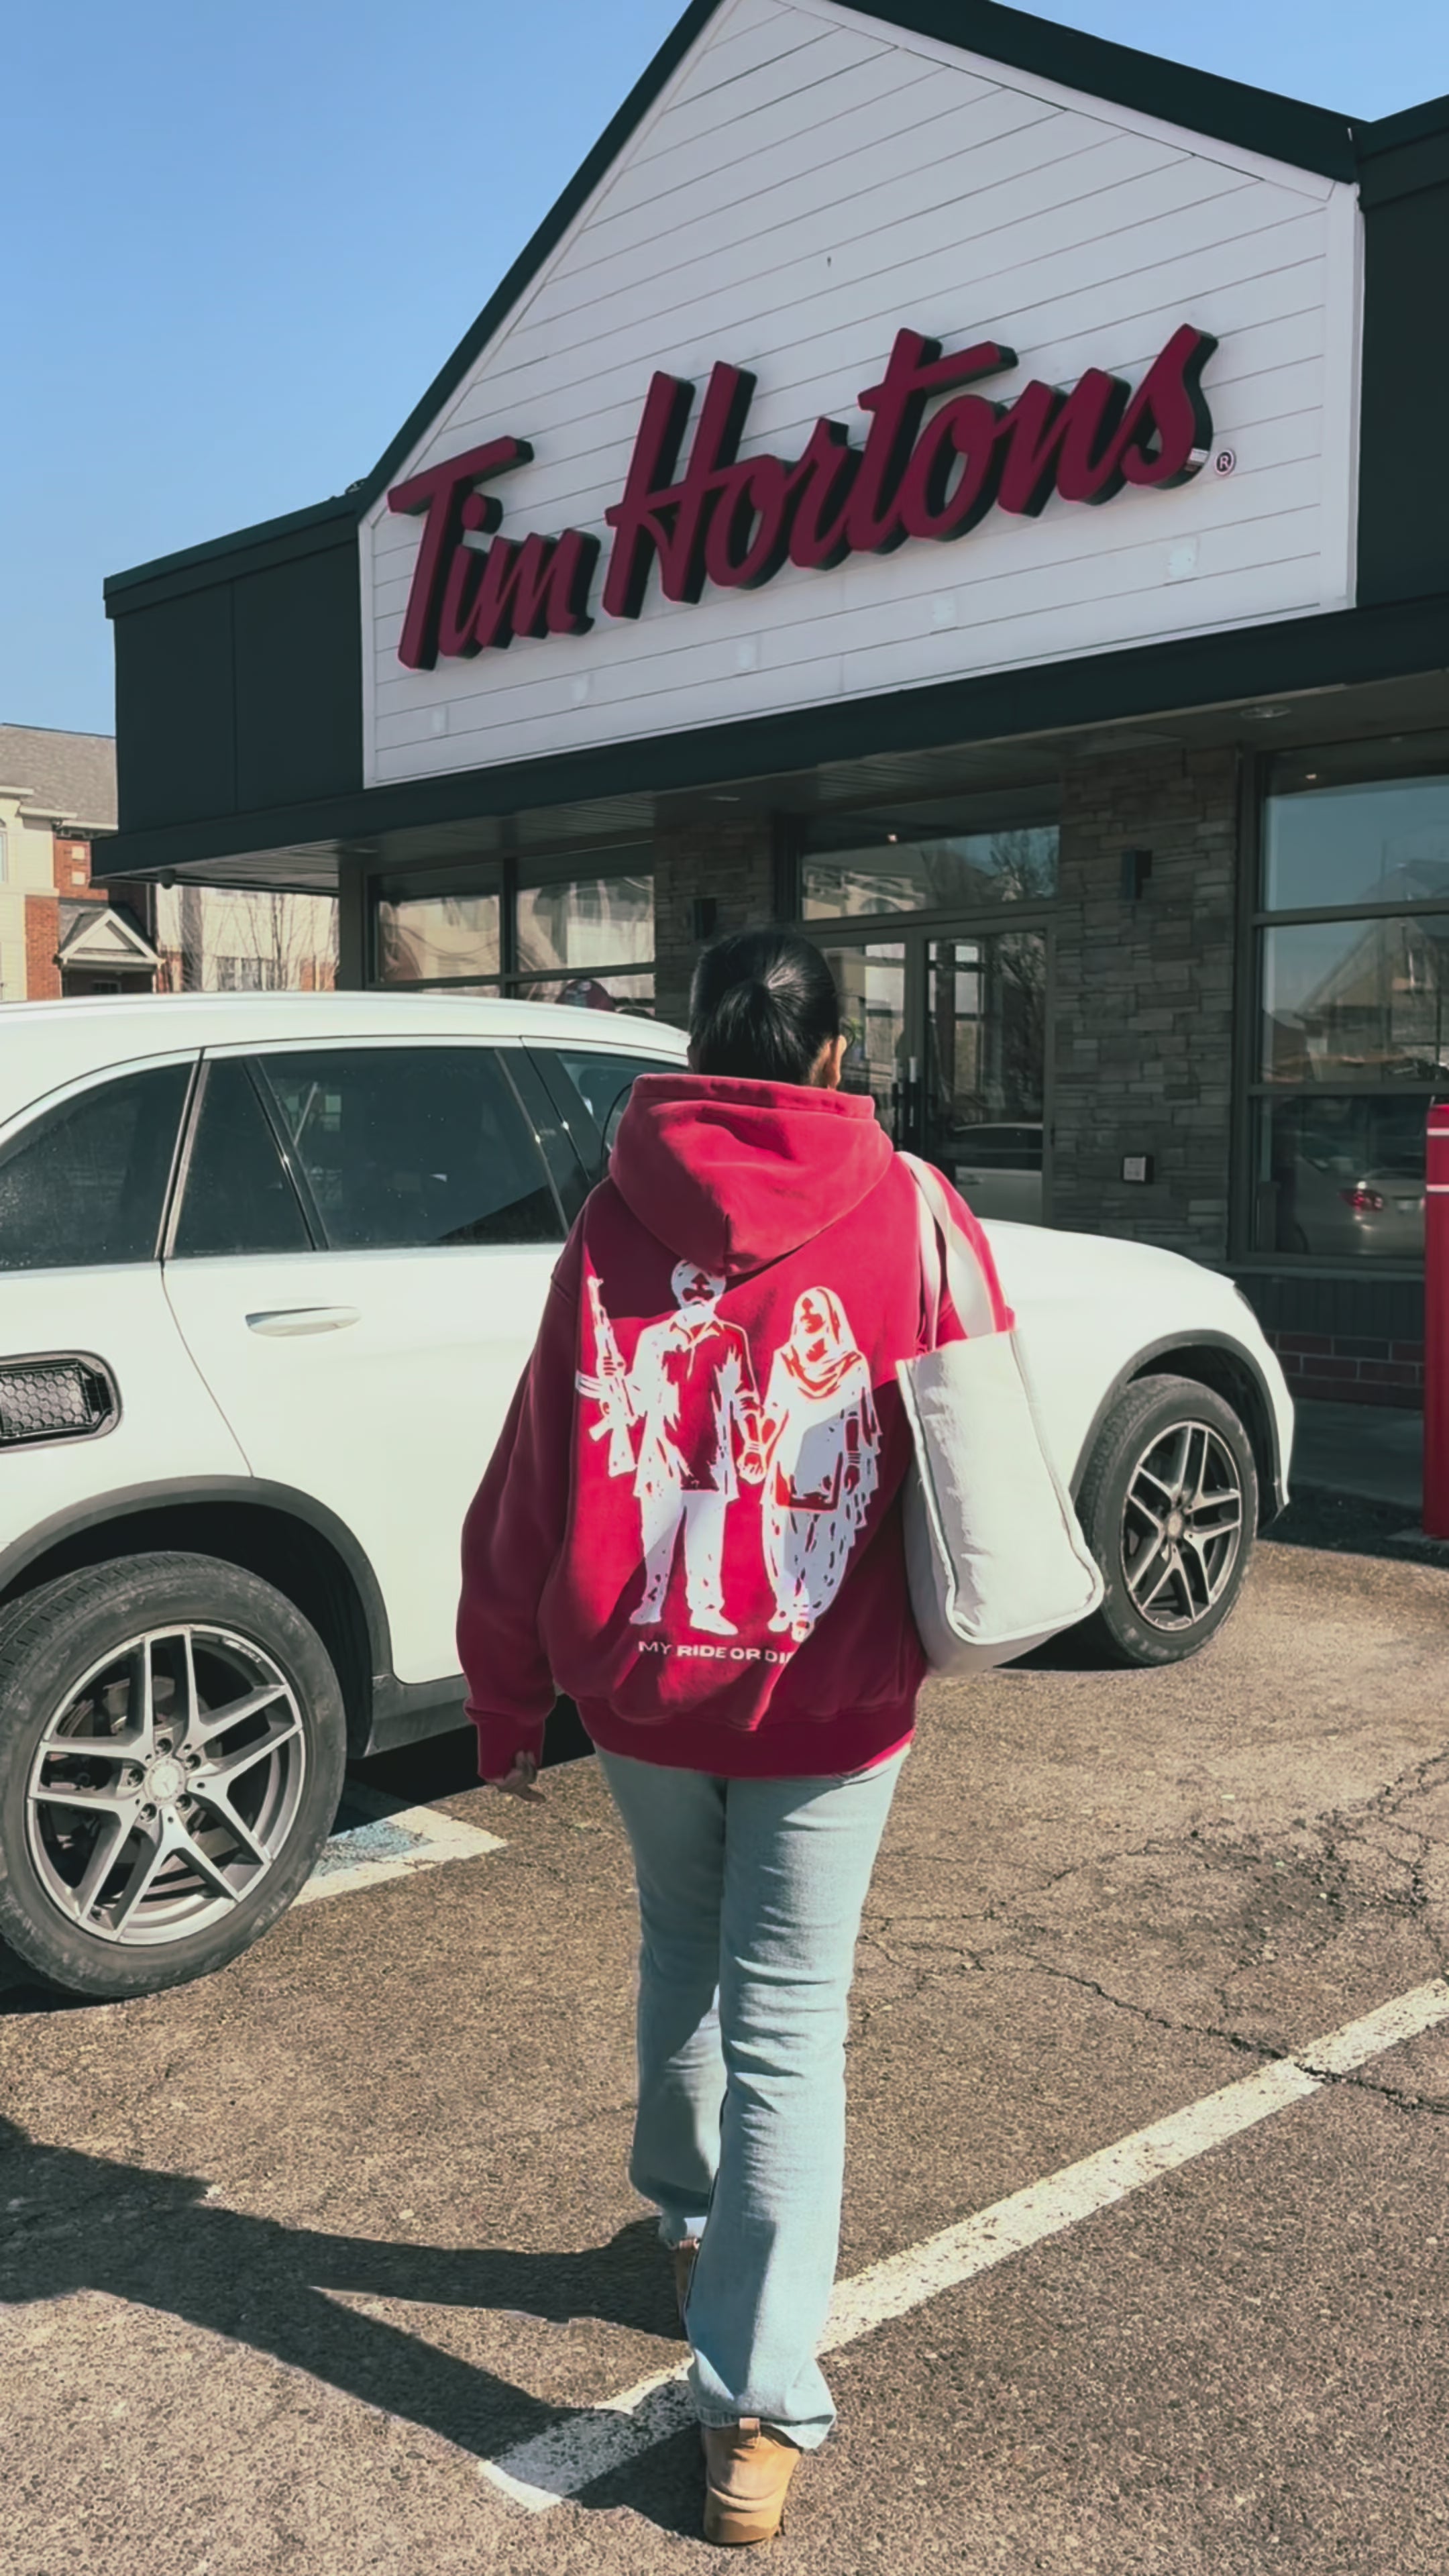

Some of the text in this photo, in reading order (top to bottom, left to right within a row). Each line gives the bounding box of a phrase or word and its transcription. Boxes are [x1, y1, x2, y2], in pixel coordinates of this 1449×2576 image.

[387, 435, 601, 672] Tim
[604, 323, 1218, 620] Hortons
[638, 1641, 672, 1655] MY
[676, 1644, 727, 1659] RIDE
[729, 1647, 761, 1660] OR
